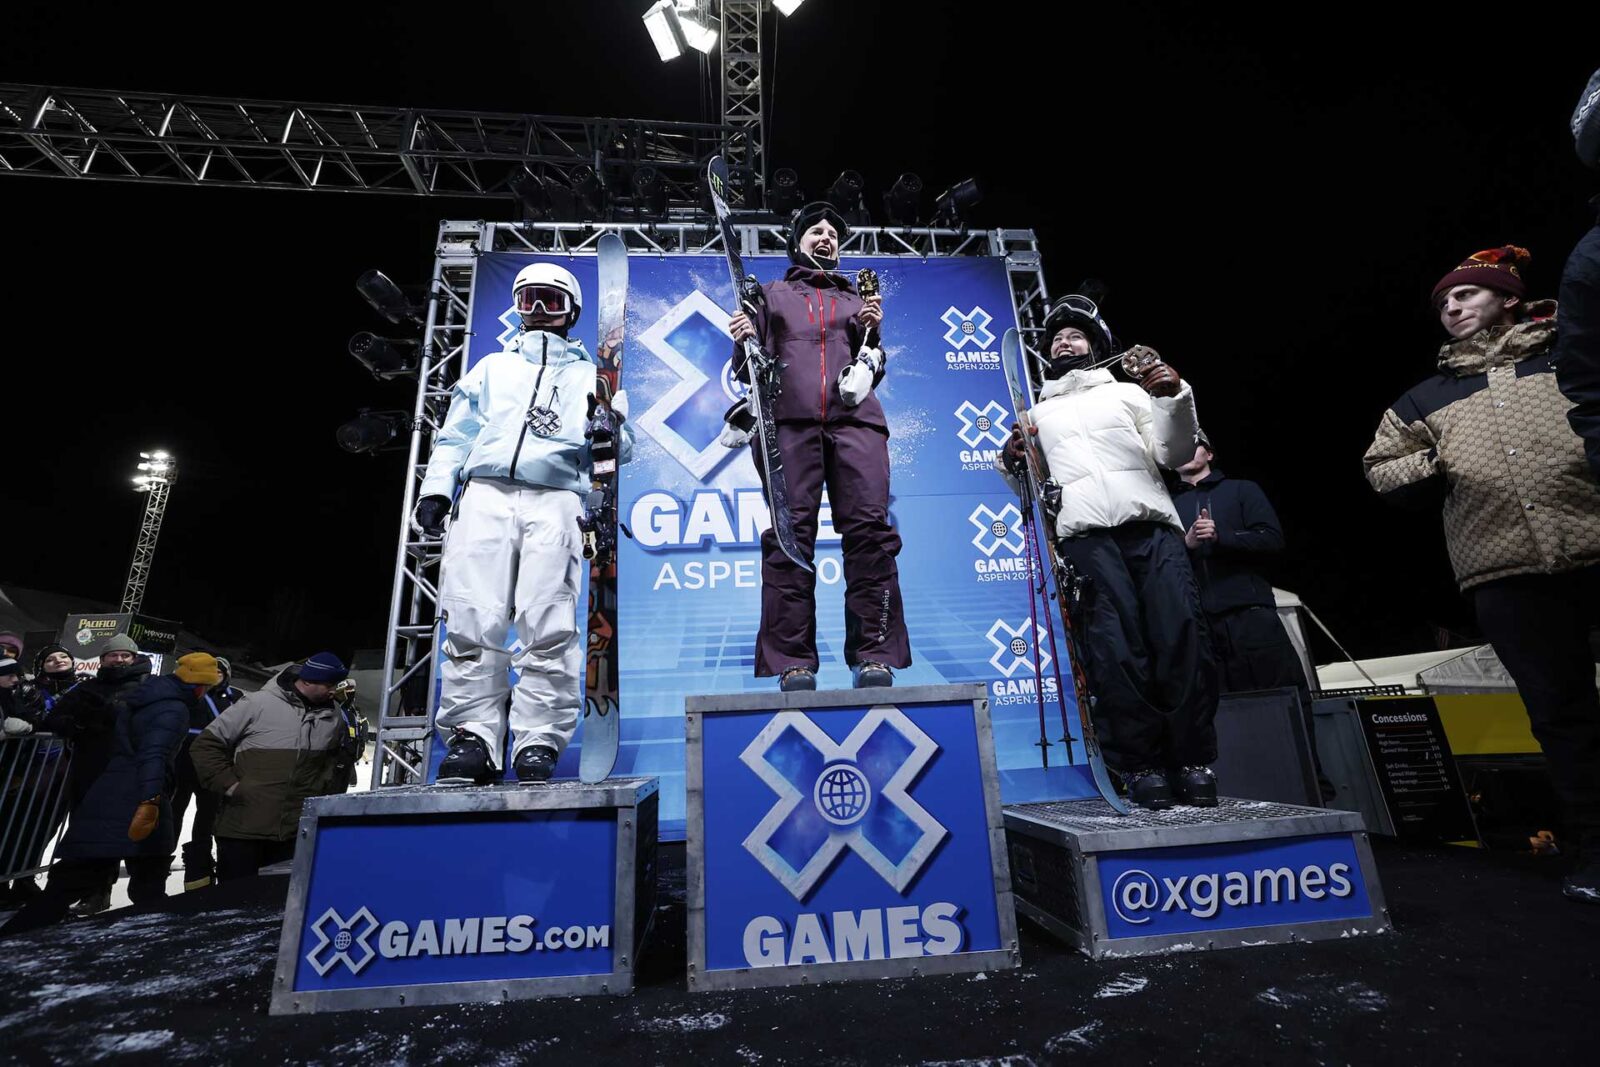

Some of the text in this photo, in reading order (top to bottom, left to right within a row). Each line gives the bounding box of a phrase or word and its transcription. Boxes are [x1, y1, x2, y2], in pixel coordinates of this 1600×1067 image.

[945, 351, 1000, 363] GAMES
[959, 449, 1003, 463] GAM
[961, 463, 994, 471] ASPEN
[630, 490, 890, 546] GAE
[974, 557, 1036, 573] GAMES
[653, 558, 763, 590] ASPE
[976, 572, 1011, 582] ASPEN
[78, 618, 117, 629] PACIFICO
[992, 677, 1057, 696] GAMES
[995, 696, 1031, 706] ASPEN
[1371, 712, 1427, 724] Concessions
[1112, 862, 1351, 924] @xgames
[378, 915, 610, 959] GAMES.COM
[743, 902, 962, 968] GAMES
